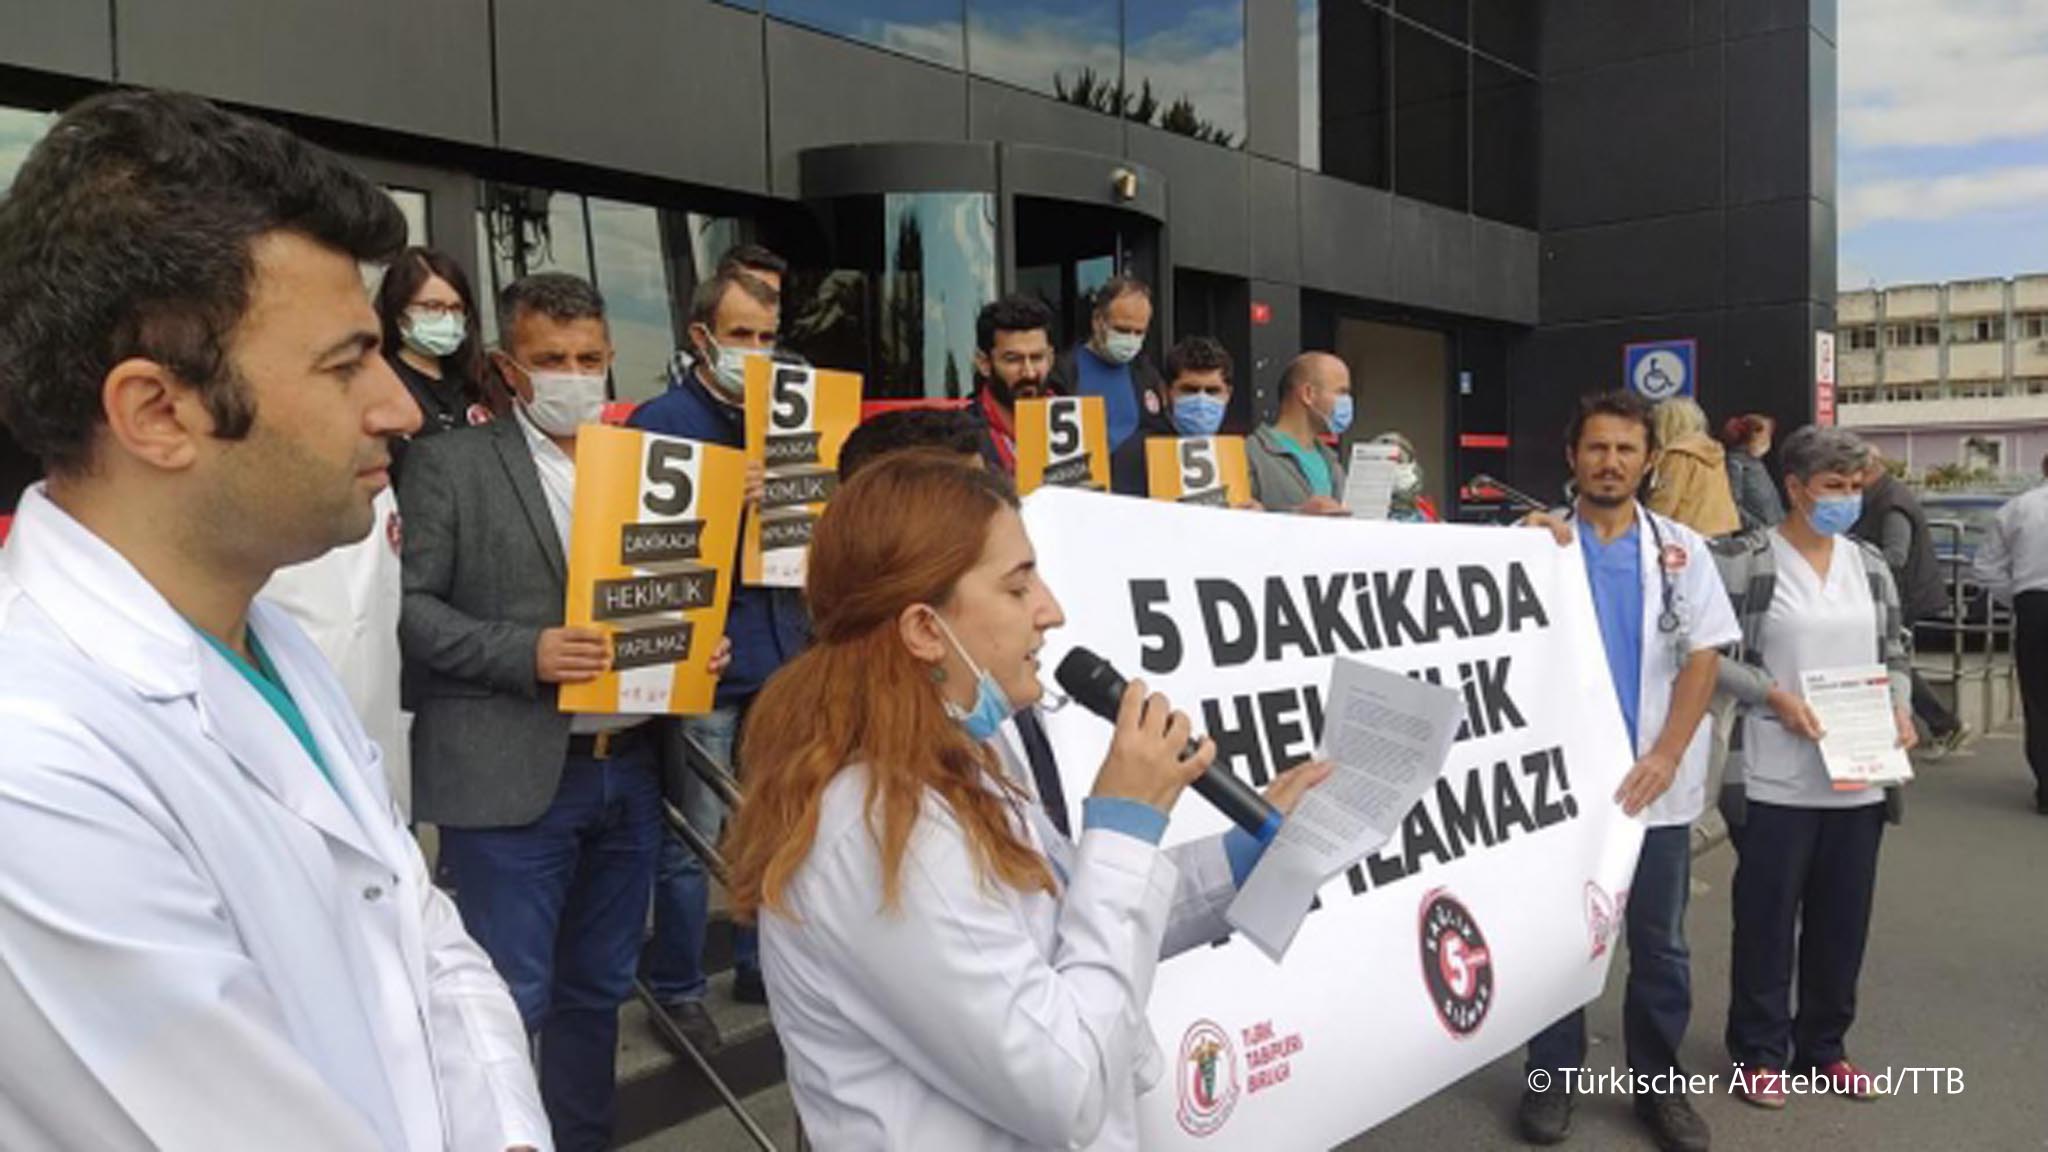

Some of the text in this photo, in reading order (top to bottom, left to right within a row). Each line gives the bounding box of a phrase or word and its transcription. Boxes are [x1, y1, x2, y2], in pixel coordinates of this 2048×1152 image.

[772, 370, 809, 429] 5
[1050, 401, 1080, 454] 5
[643, 439, 693, 517] 5
[1181, 441, 1215, 489] 5
[1129, 579, 1184, 674] 5
[1445, 935, 1470, 998] 5
